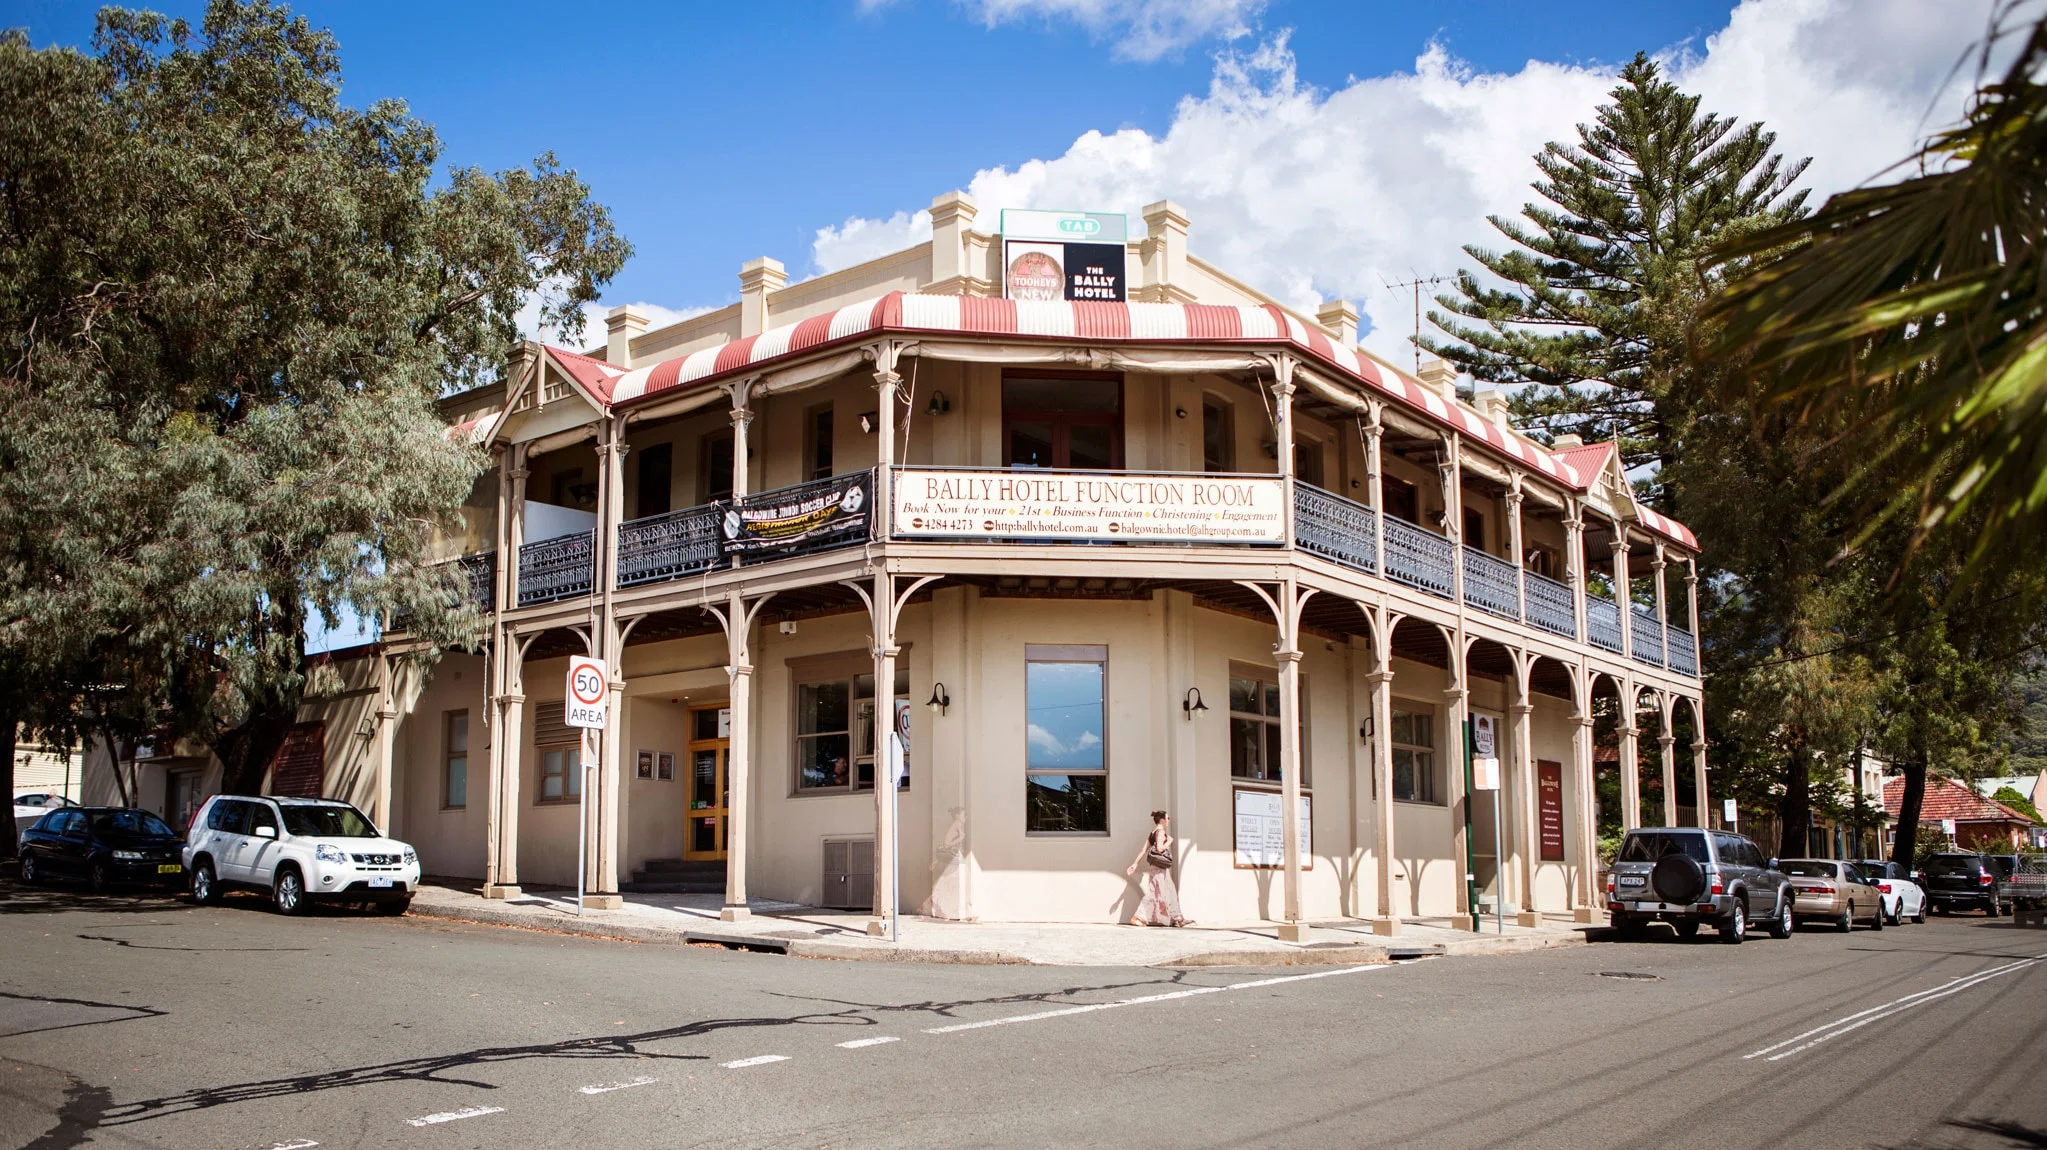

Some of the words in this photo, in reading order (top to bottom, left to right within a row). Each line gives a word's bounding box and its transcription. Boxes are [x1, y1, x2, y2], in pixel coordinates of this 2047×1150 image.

[1064, 221, 1093, 232] TAB
[1015, 277, 1057, 287] TOOHEYS
[1074, 275, 1116, 286] BALLY
[1021, 288, 1054, 300] NEW
[1074, 287, 1116, 298] HOTEL
[925, 477, 993, 500] BALLY
[1000, 479, 1070, 502] HOTEL
[1075, 481, 1184, 505] FUNCTION
[1192, 483, 1254, 507] ROOM
[903, 502, 929, 514] Book
[935, 503, 960, 514] Now
[964, 503, 979, 514] for
[982, 507, 1007, 518] your
[1019, 505, 1041, 516] 21st
[1053, 505, 1096, 517] Business
[1098, 506, 1143, 518] Function
[1153, 507, 1212, 522] Christening
[1222, 509, 1278, 522] Engagement
[925, 519, 947, 530] 4284
[950, 519, 973, 531] 4273
[995, 519, 1098, 533] http:ballyhotel.com.au
[577, 674, 599, 694] 50
[571, 708, 604, 723] AREA
